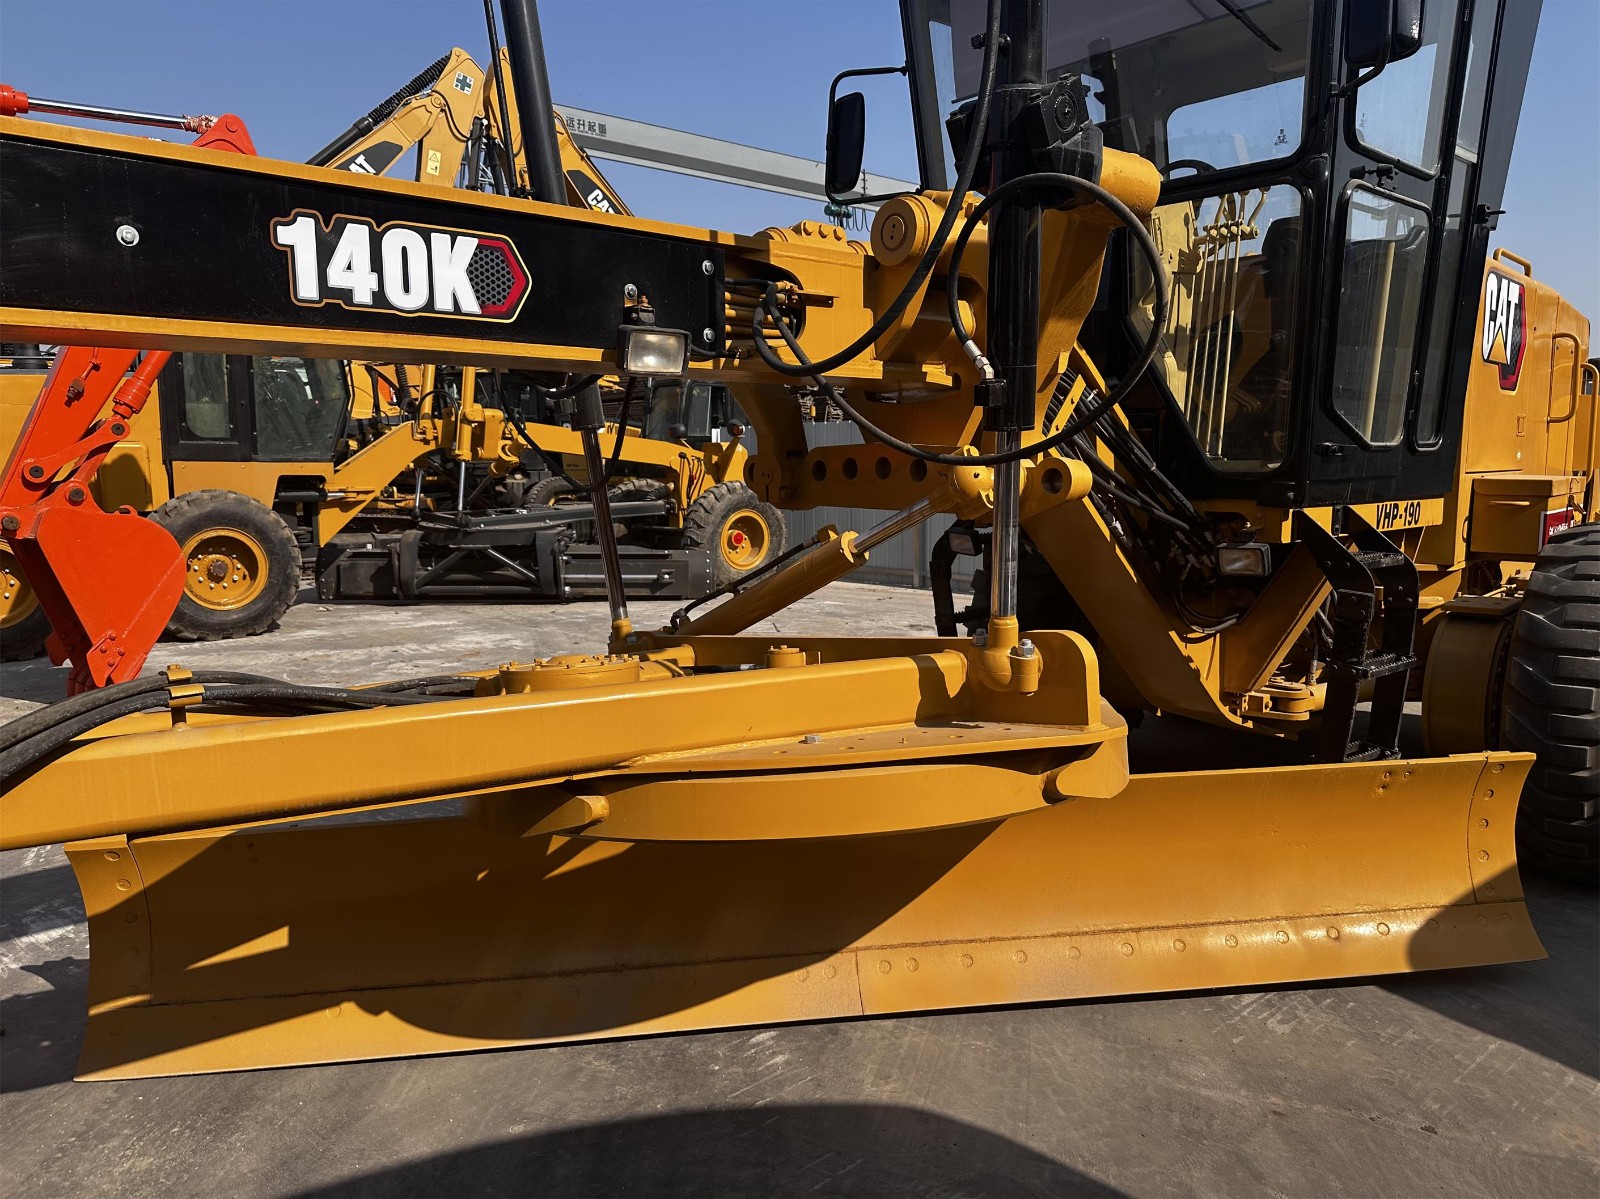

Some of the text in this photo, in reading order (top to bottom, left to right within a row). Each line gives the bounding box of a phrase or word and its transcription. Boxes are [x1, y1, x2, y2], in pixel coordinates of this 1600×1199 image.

[348, 154, 377, 176] AT
[276, 216, 482, 315] 140K
[1482, 272, 1520, 365] CAT
[1376, 501, 1421, 530] VHP-190
